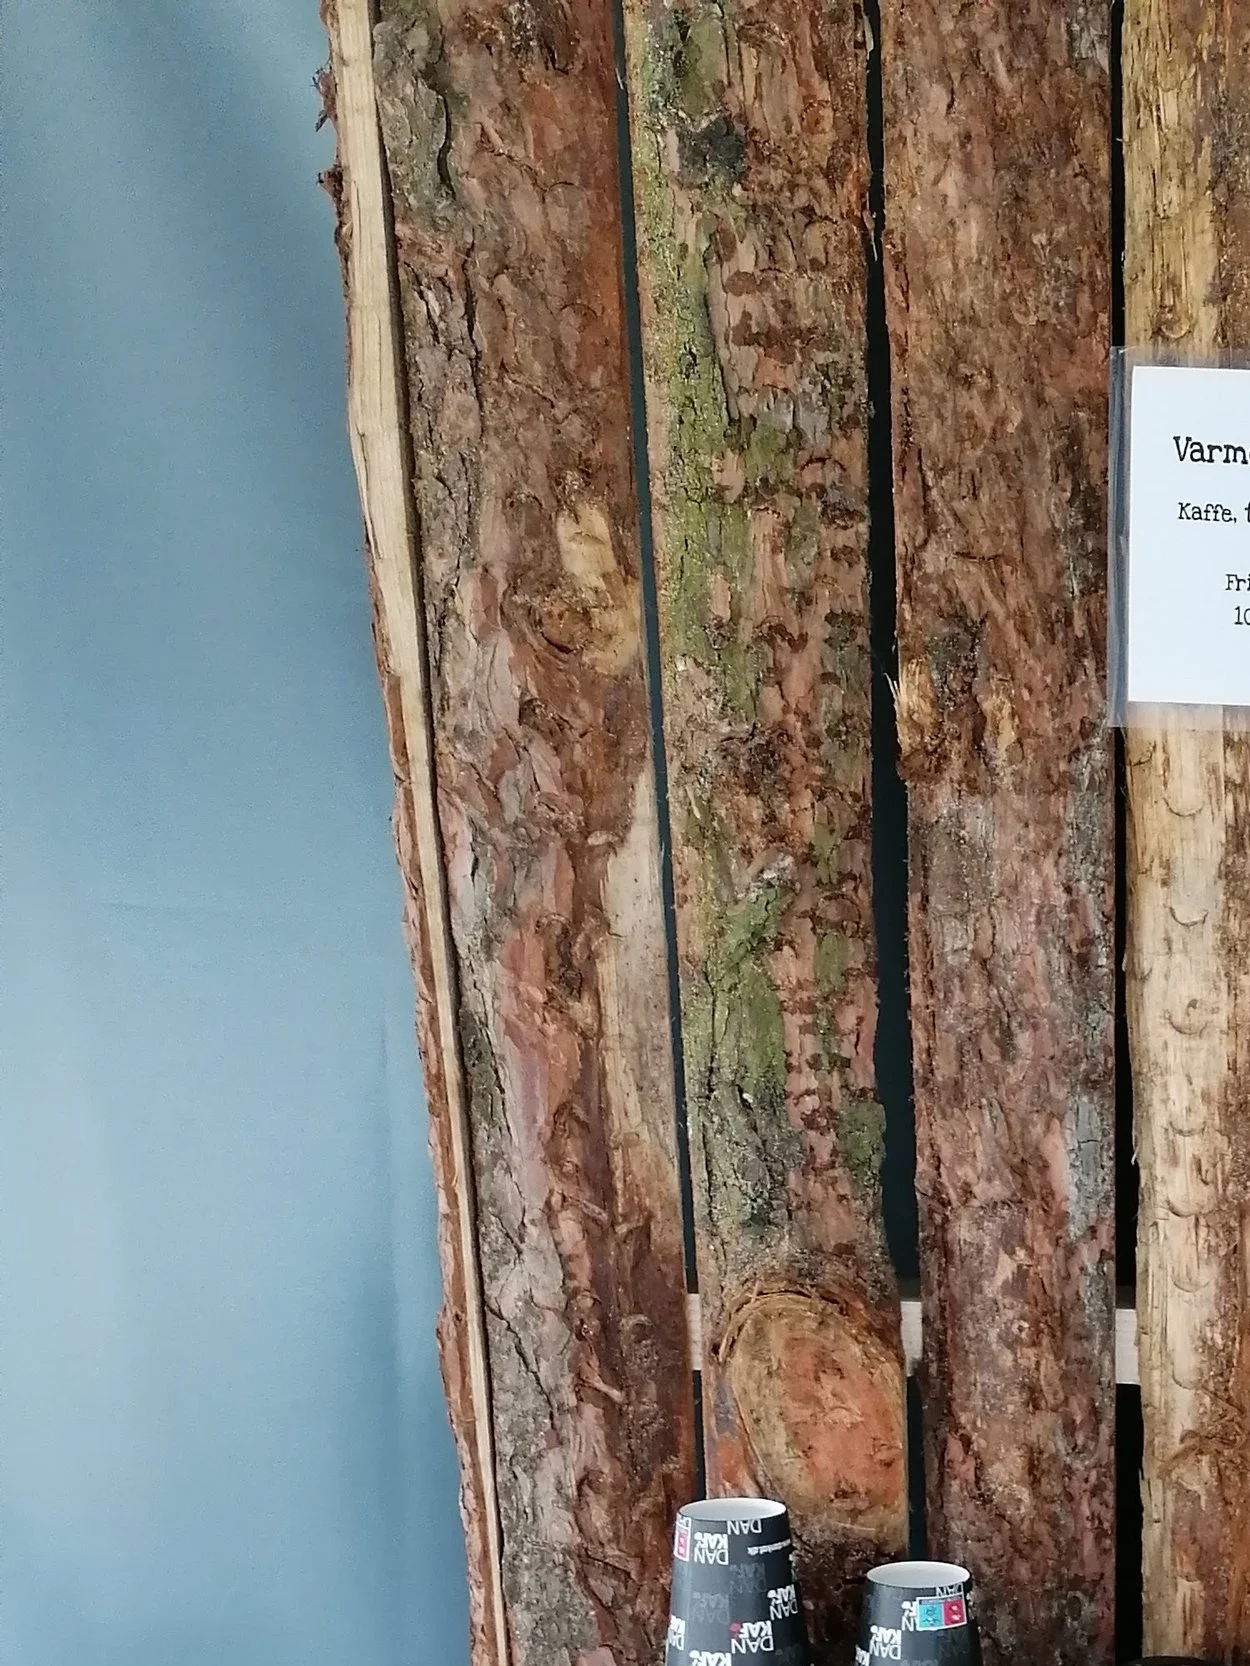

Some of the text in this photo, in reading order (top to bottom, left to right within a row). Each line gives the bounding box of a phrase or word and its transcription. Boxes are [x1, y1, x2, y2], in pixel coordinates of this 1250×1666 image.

[1177, 502, 1238, 525] Kaffe,
[727, 1519, 762, 1535] DAN
[694, 1548, 729, 1565] DAN
[769, 1600, 799, 1621] DAN
[731, 1636, 774, 1654] DAN
[869, 1640, 901, 1660] DAN
